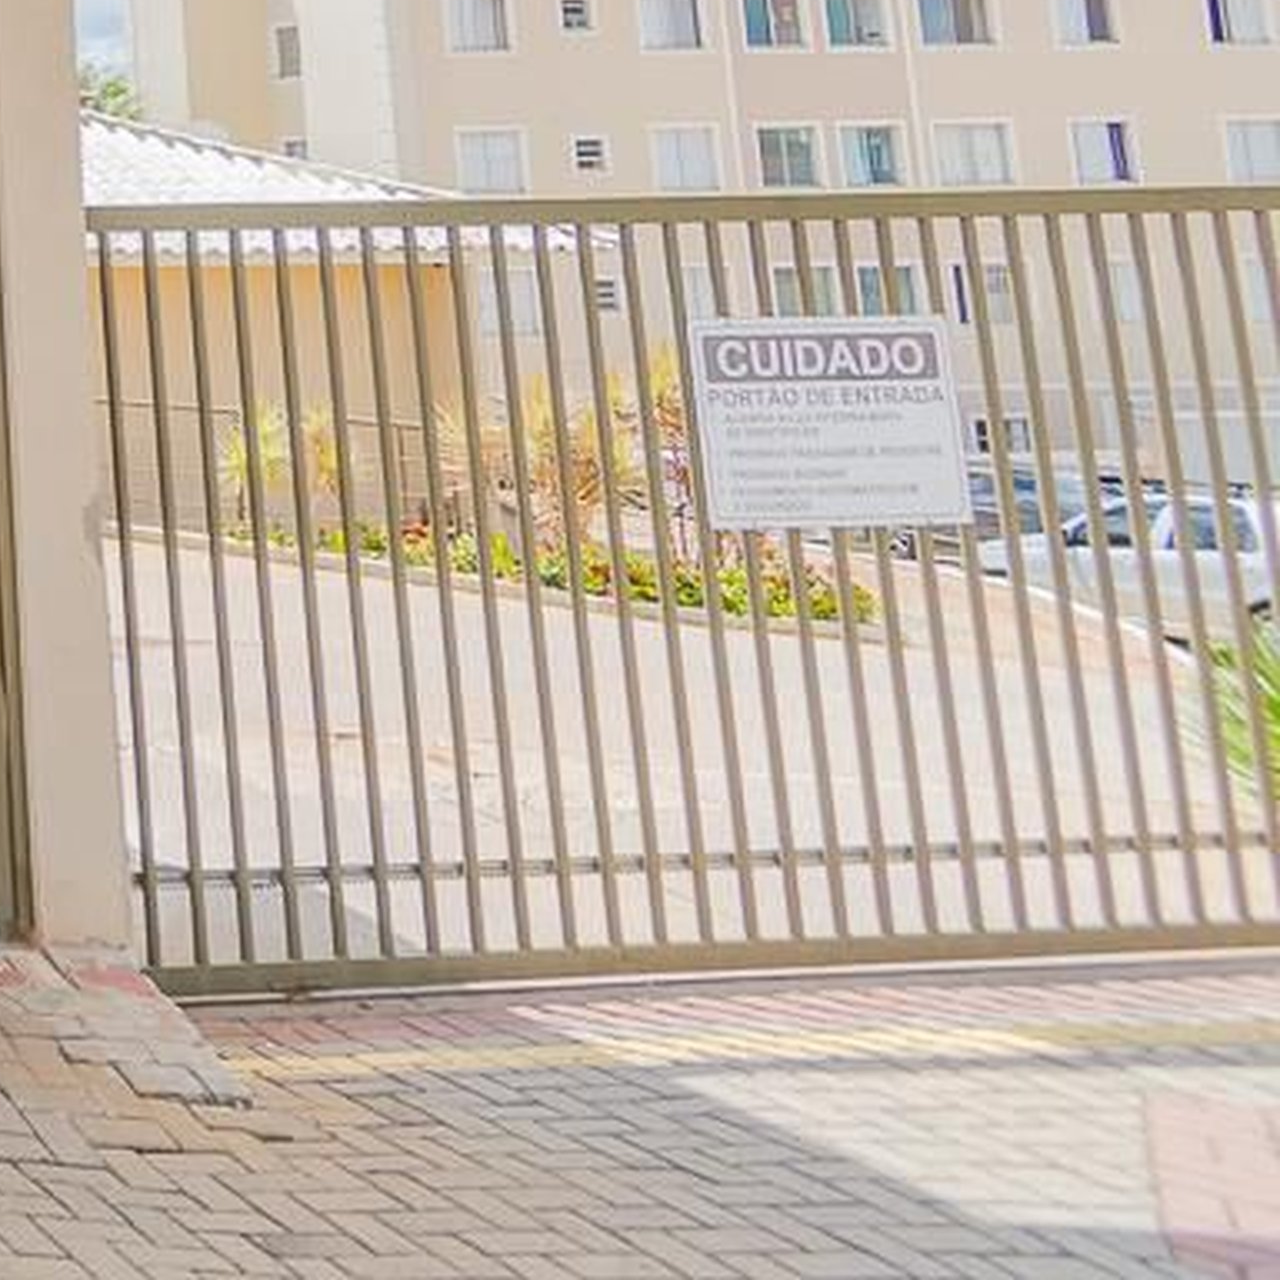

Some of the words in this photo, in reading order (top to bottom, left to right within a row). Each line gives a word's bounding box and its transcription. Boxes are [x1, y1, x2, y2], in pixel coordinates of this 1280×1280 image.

[716, 337, 925, 378] CUIDADO
[807, 388, 838, 406] DE
[841, 387, 944, 406] ENTRADA
